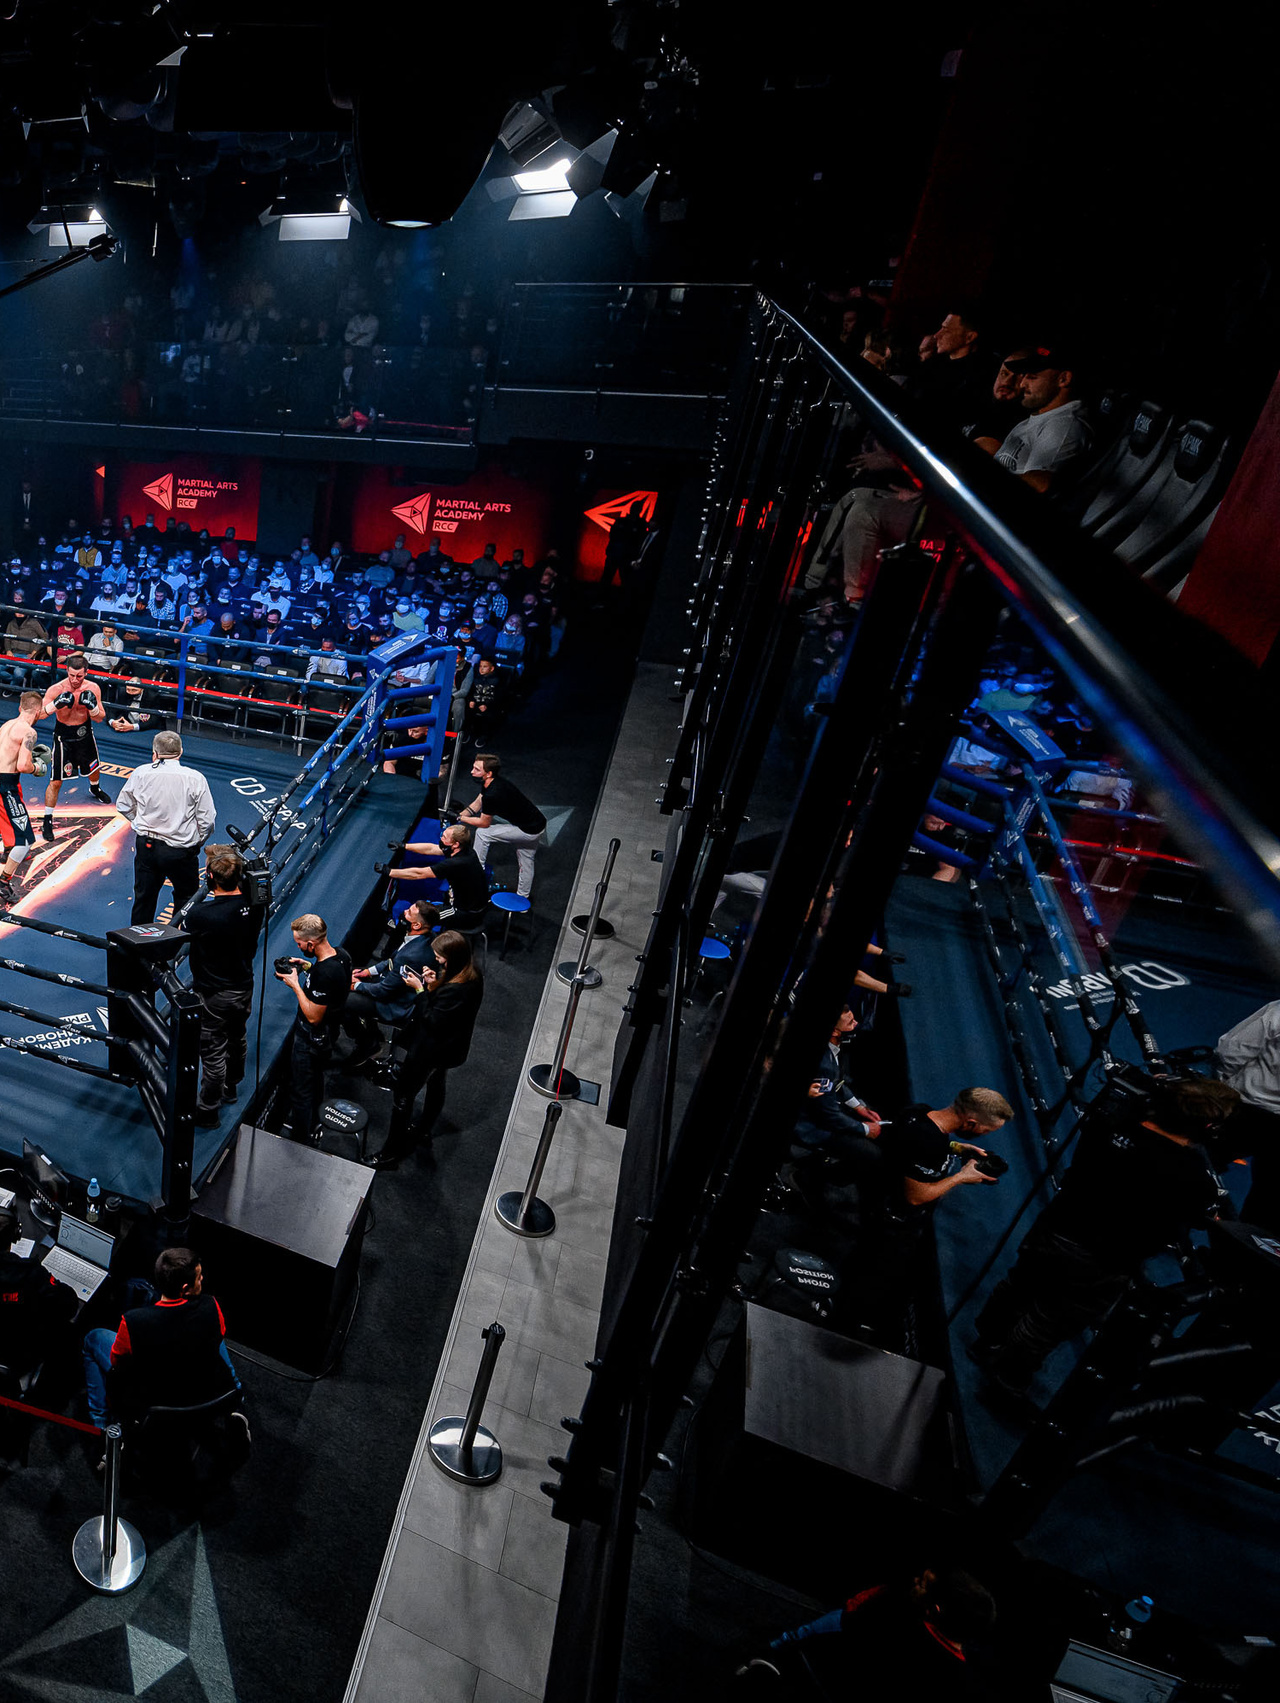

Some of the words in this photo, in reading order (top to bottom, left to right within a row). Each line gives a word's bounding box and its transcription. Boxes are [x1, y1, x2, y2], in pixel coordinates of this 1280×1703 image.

[177, 478, 214, 489] MARTIAL
[216, 481, 238, 491] ARTS
[177, 488, 218, 498] ACADEMY
[178, 499, 194, 507] RCC
[436, 499, 480, 511] MARTIAL
[483, 502, 511, 513] ARTS
[434, 509, 485, 521] ACADEMY
[434, 522, 454, 530] RCC
[324, 1106, 356, 1124] POSITION
[325, 1113, 348, 1128] PHOTO
